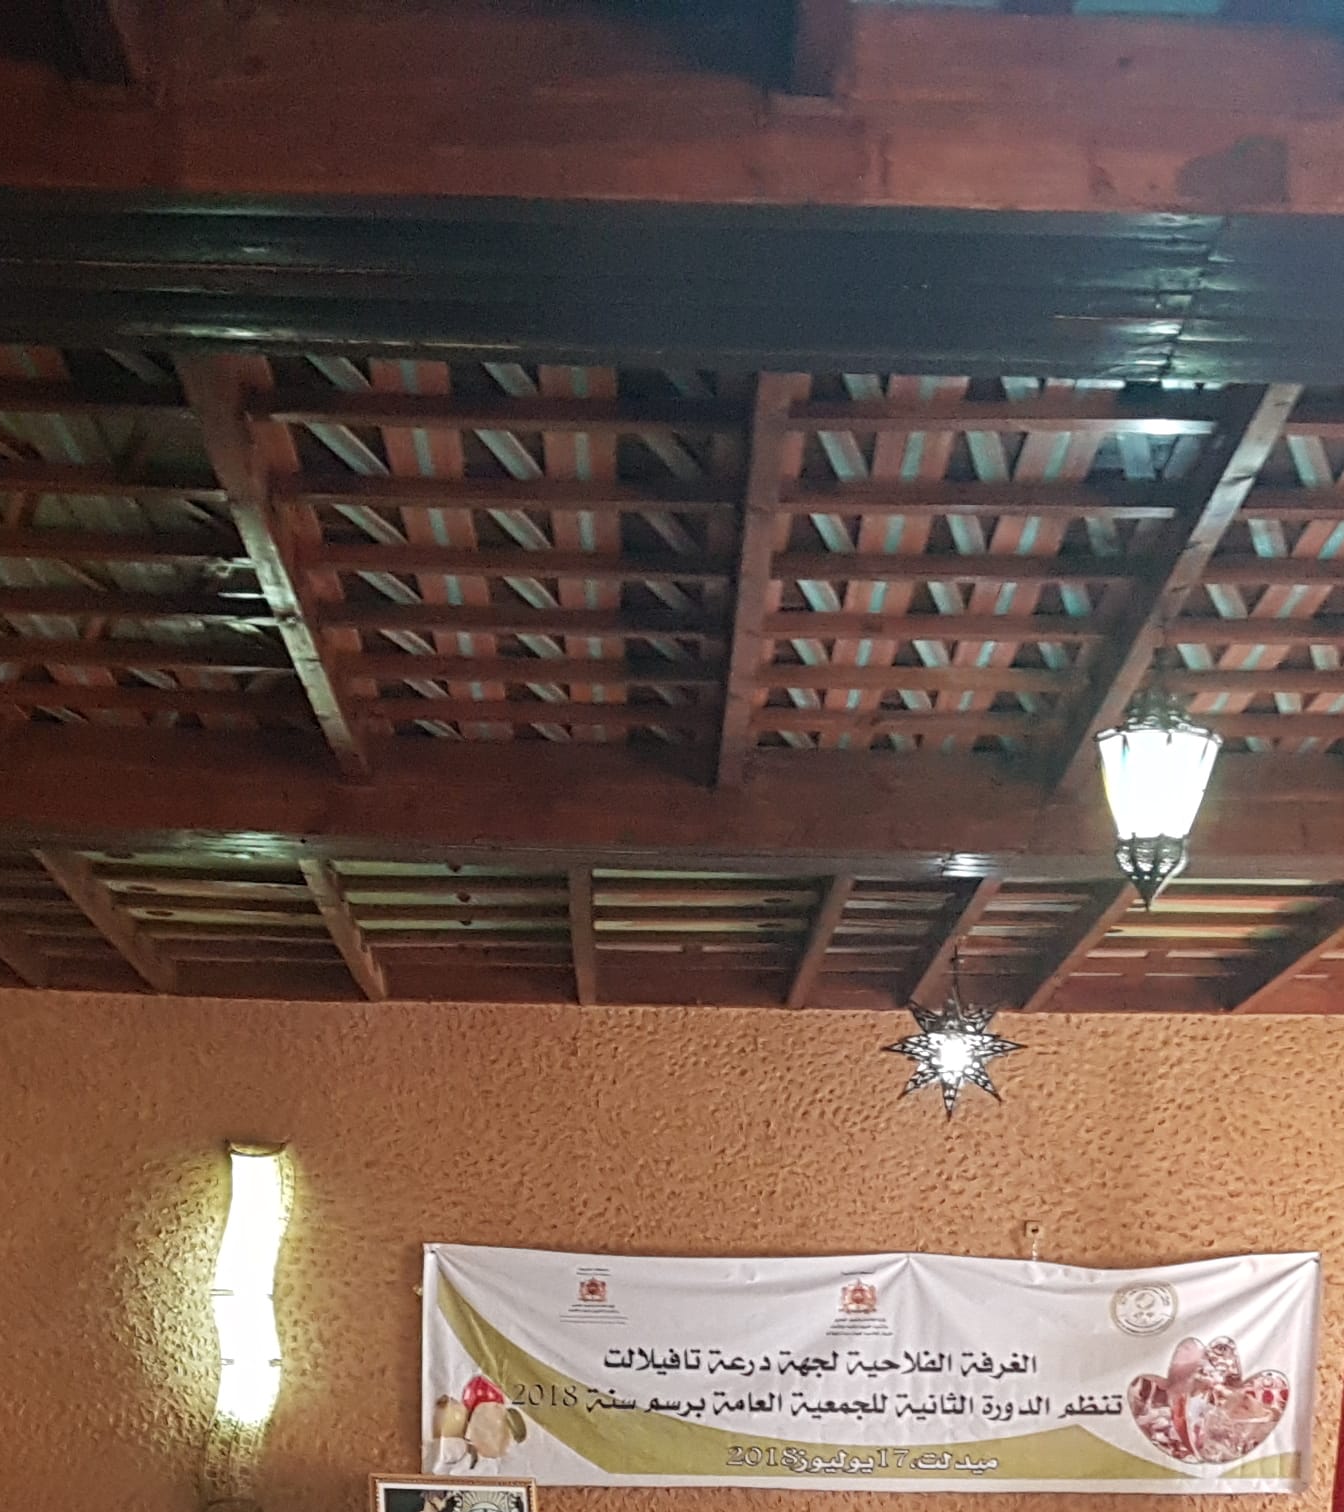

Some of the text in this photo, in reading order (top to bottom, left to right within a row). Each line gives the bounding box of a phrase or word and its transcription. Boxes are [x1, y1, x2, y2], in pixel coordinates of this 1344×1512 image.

[603, 1347, 1037, 1379] الغرفة الفلاحية لجهة درعة تافيلالت
[512, 1383, 1123, 1422] تنظم الدورة الثانية للجمعية العامة برسم سنة 2018
